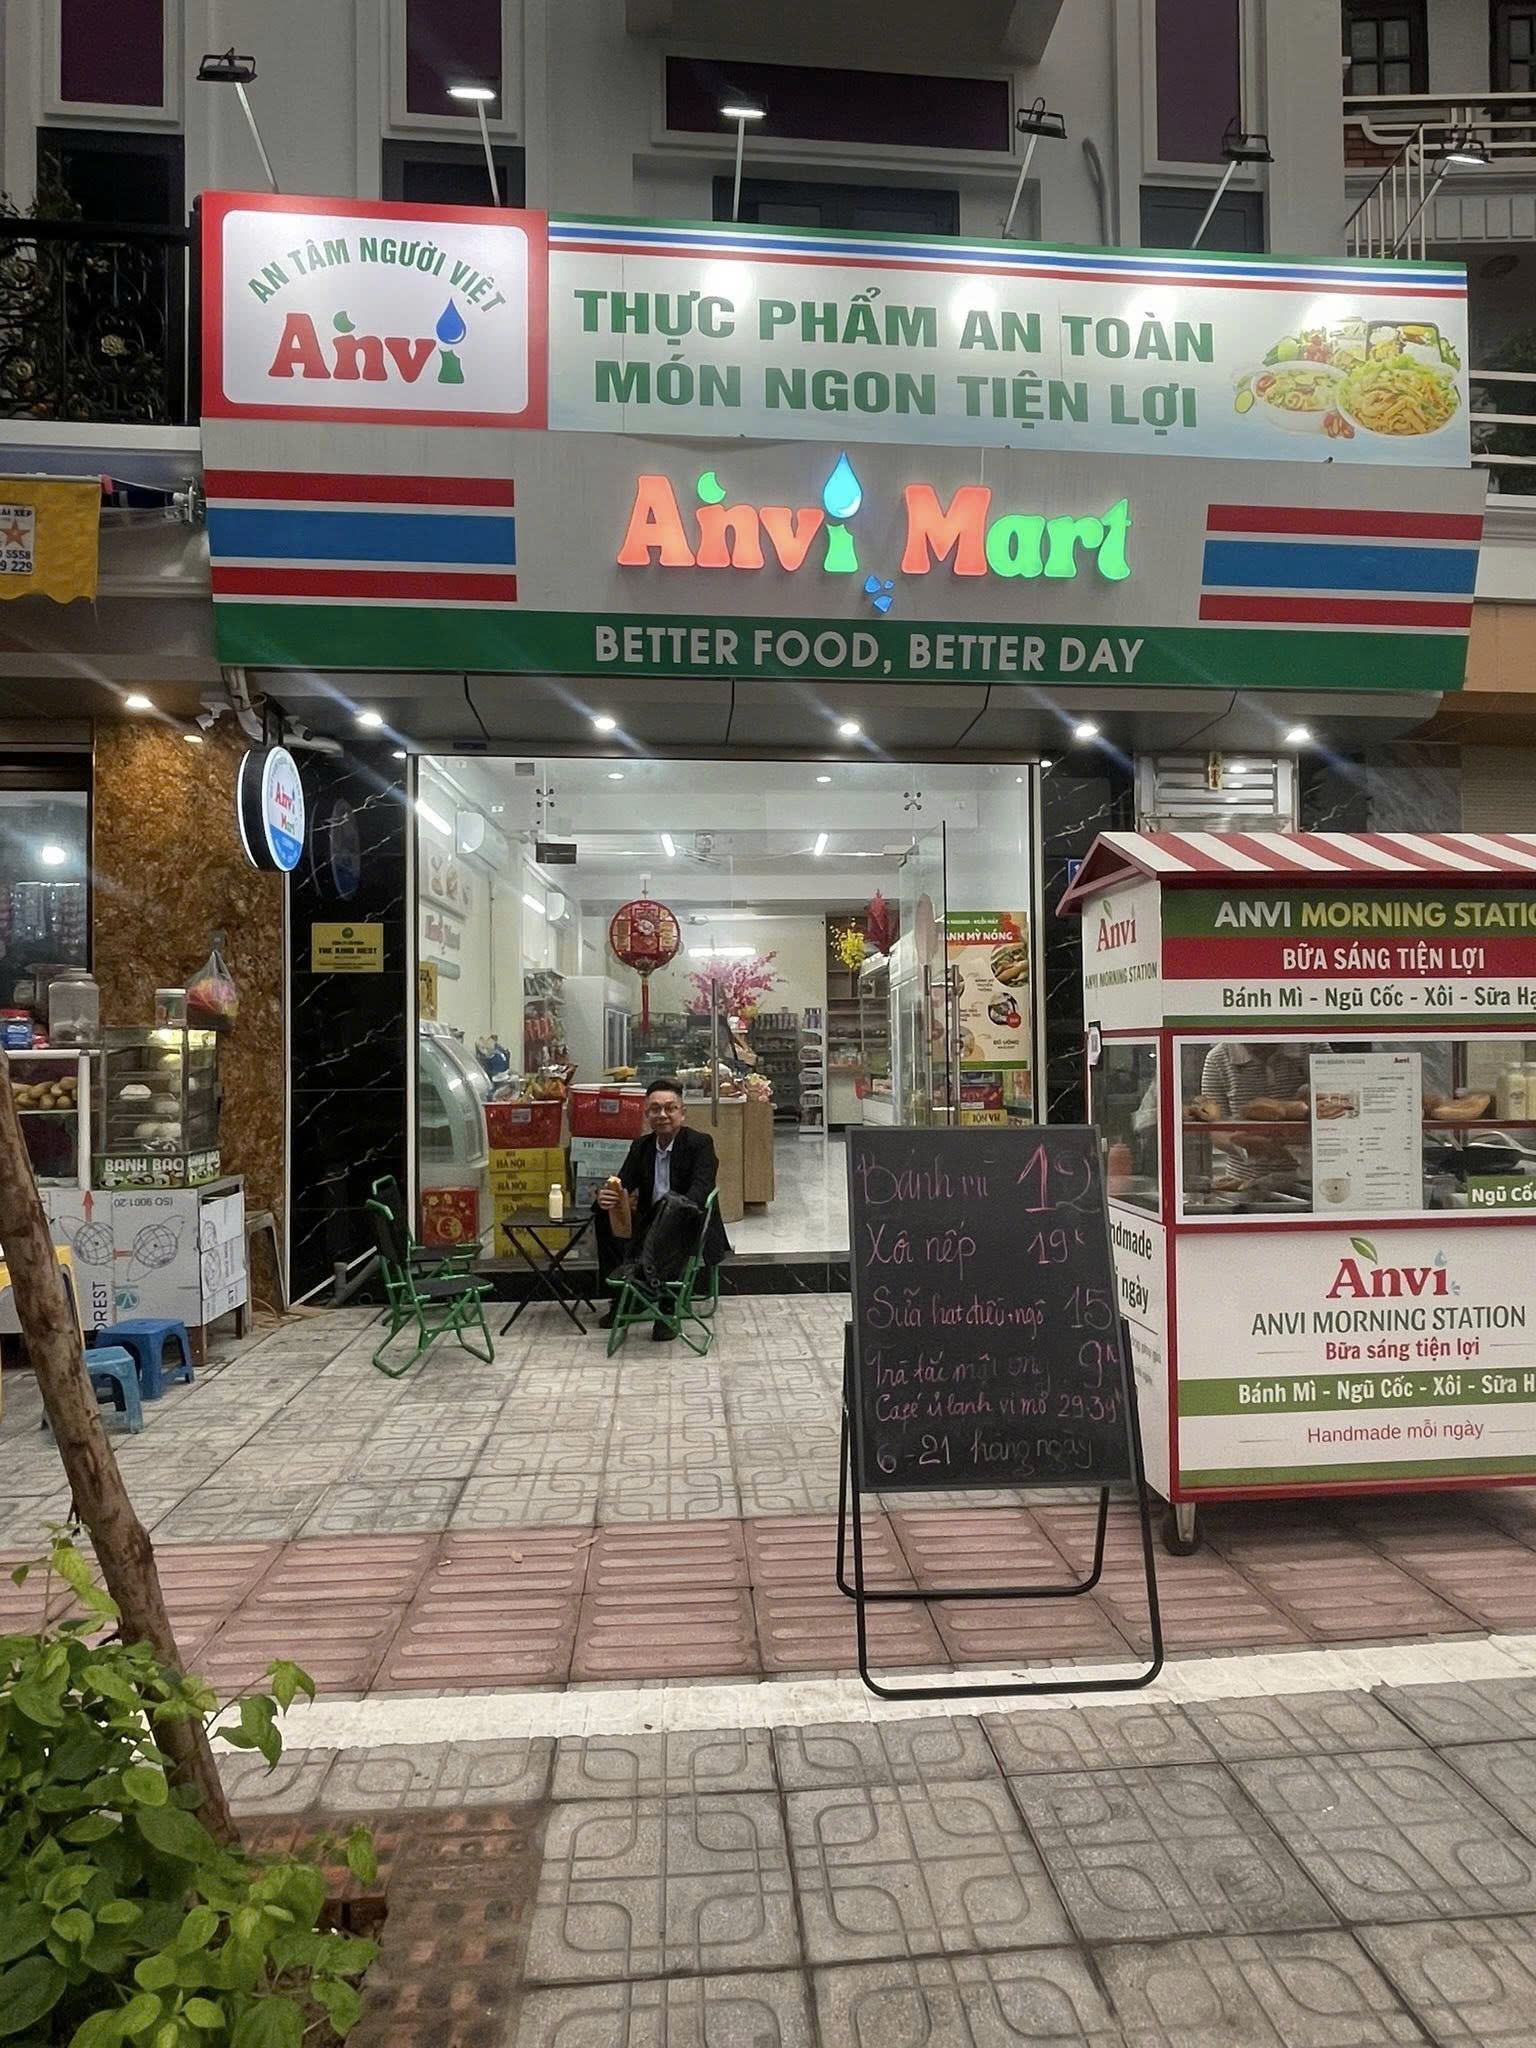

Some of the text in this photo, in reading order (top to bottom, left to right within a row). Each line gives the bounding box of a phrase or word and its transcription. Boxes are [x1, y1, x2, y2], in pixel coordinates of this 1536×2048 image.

[248, 237, 507, 313] AN TÂM NGƯỜI VIỆT
[268, 298, 467, 384] Anvi
[574, 287, 1214, 363] THỰC PHẨM AN TOÀN
[595, 353, 1198, 436] MÓN NGON TIỆN LỢI
[617, 452, 1131, 581] Anvi Mart
[11, 561, 33, 572] 229
[595, 625, 1145, 674] BETTER FOOD, BETTER DAY
[1096, 913, 1136, 952] Anvi
[1214, 901, 1291, 928] ANVI
[1301, 901, 1447, 928] MORNING
[983, 928, 1013, 940] NÓNG
[1128, 962, 1158, 983] STATION
[1282, 940, 1485, 975] BỮA SÁNG TIỆN LỢI
[1222, 985, 1272, 1008] Bánh
[1279, 985, 1303, 1008] Mì
[1325, 986, 1364, 1010] Ngũ
[1370, 983, 1404, 1007] Cốc
[1424, 985, 1454, 1006] Xôi
[1474, 985, 1511, 1006] Sữa
[1471, 1185, 1506, 1205] Ngũ
[866, 1223, 914, 1267] Xôi
[926, 1220, 977, 1281] nếp
[1111, 1221, 1152, 1261] ndmade
[1325, 1251, 1449, 1300] Anvi
[1121, 1276, 1149, 1314] ngày
[1252, 1305, 1526, 1336] ANVI MORNING STATION
[1325, 1336, 1480, 1362] Bữa sáng tiện lợi
[1239, 1381, 1287, 1404] Bánh
[1293, 1379, 1316, 1402] Mì
[1337, 1380, 1375, 1403] Ngũ
[1380, 1375, 1413, 1399] Cốc
[1433, 1376, 1462, 1397] Xôi
[1481, 1374, 1517, 1394] Sữa
[1308, 1418, 1484, 1443] Handmade mỗi ngày
